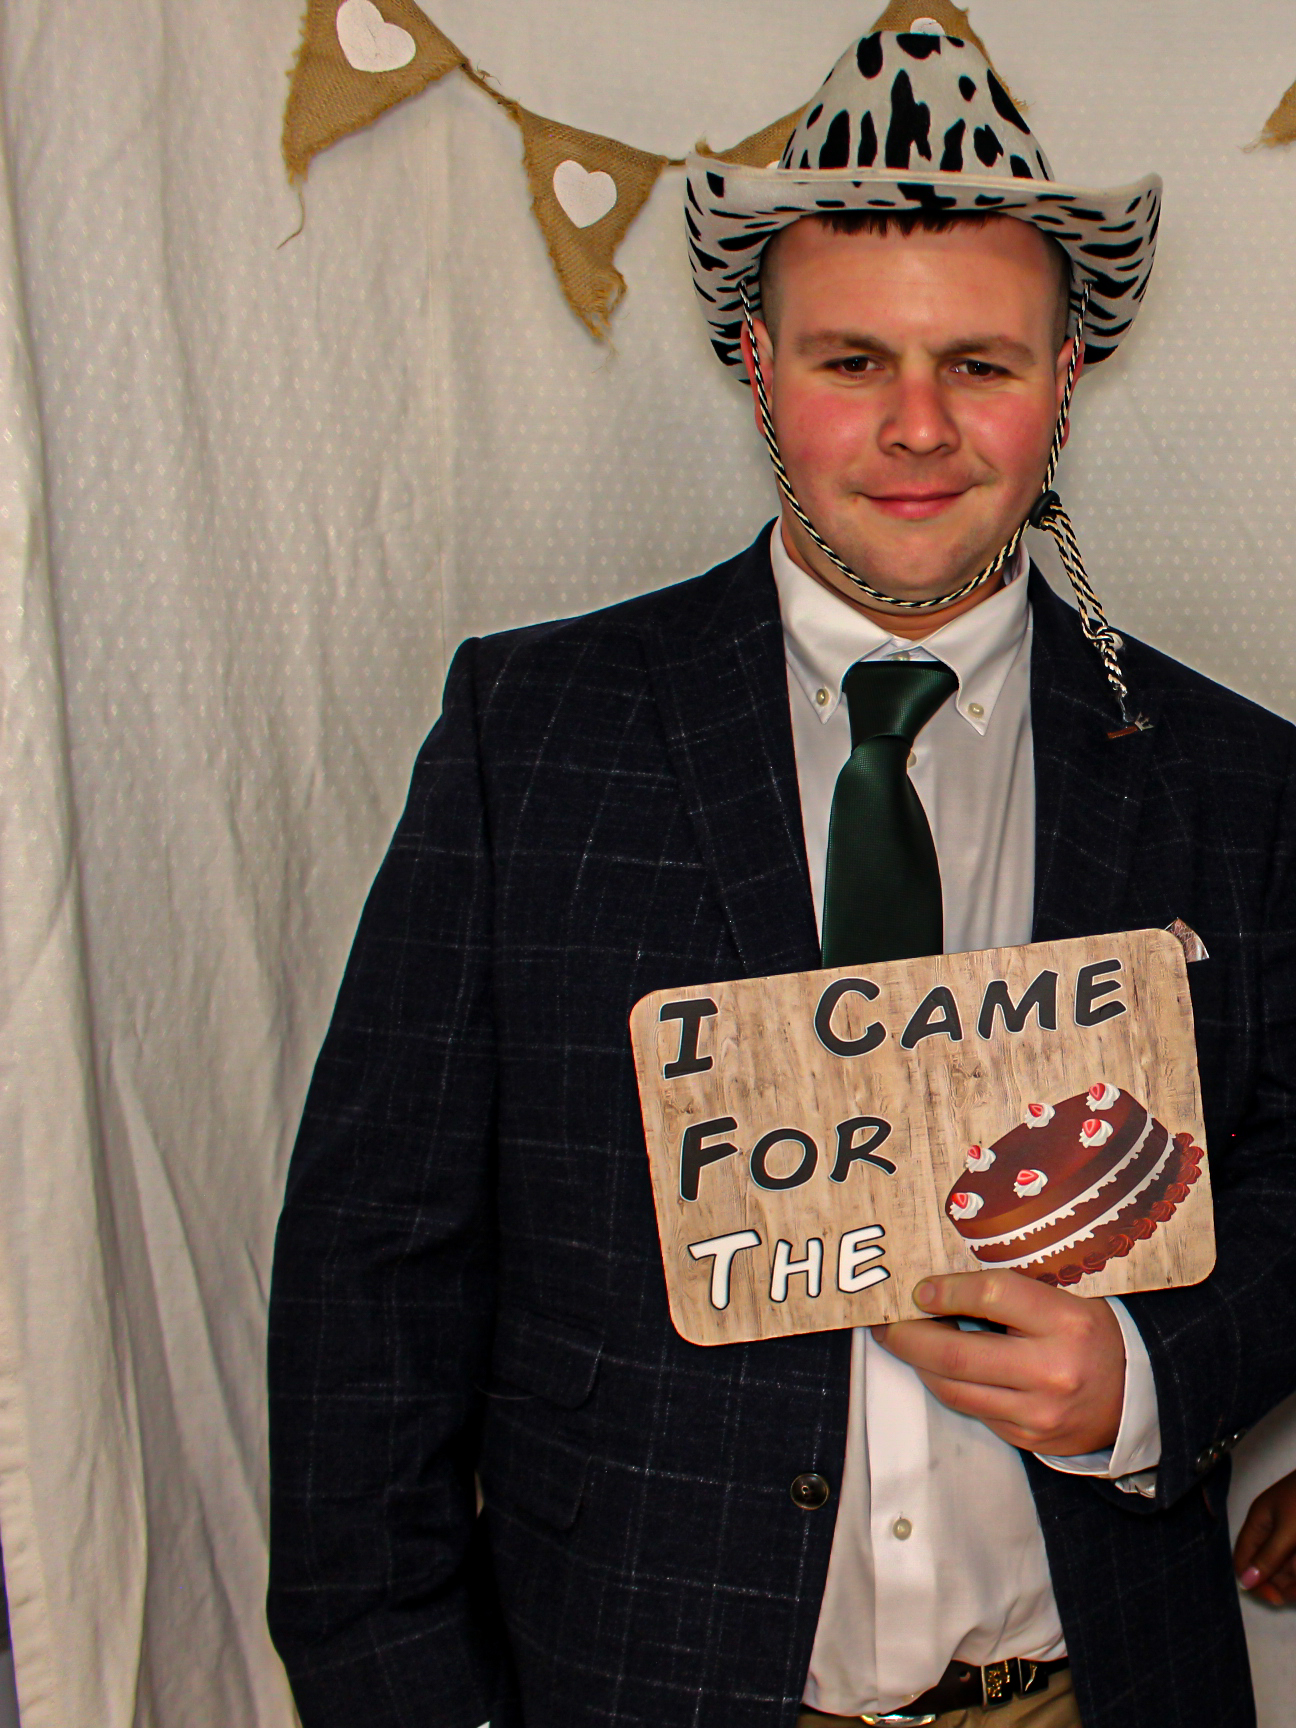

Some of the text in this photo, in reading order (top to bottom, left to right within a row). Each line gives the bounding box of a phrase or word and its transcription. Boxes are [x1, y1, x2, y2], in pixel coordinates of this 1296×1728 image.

[660, 958, 1128, 1080] I CAME
[679, 1116, 897, 1202] FOR
[688, 1224, 891, 1310] THE
